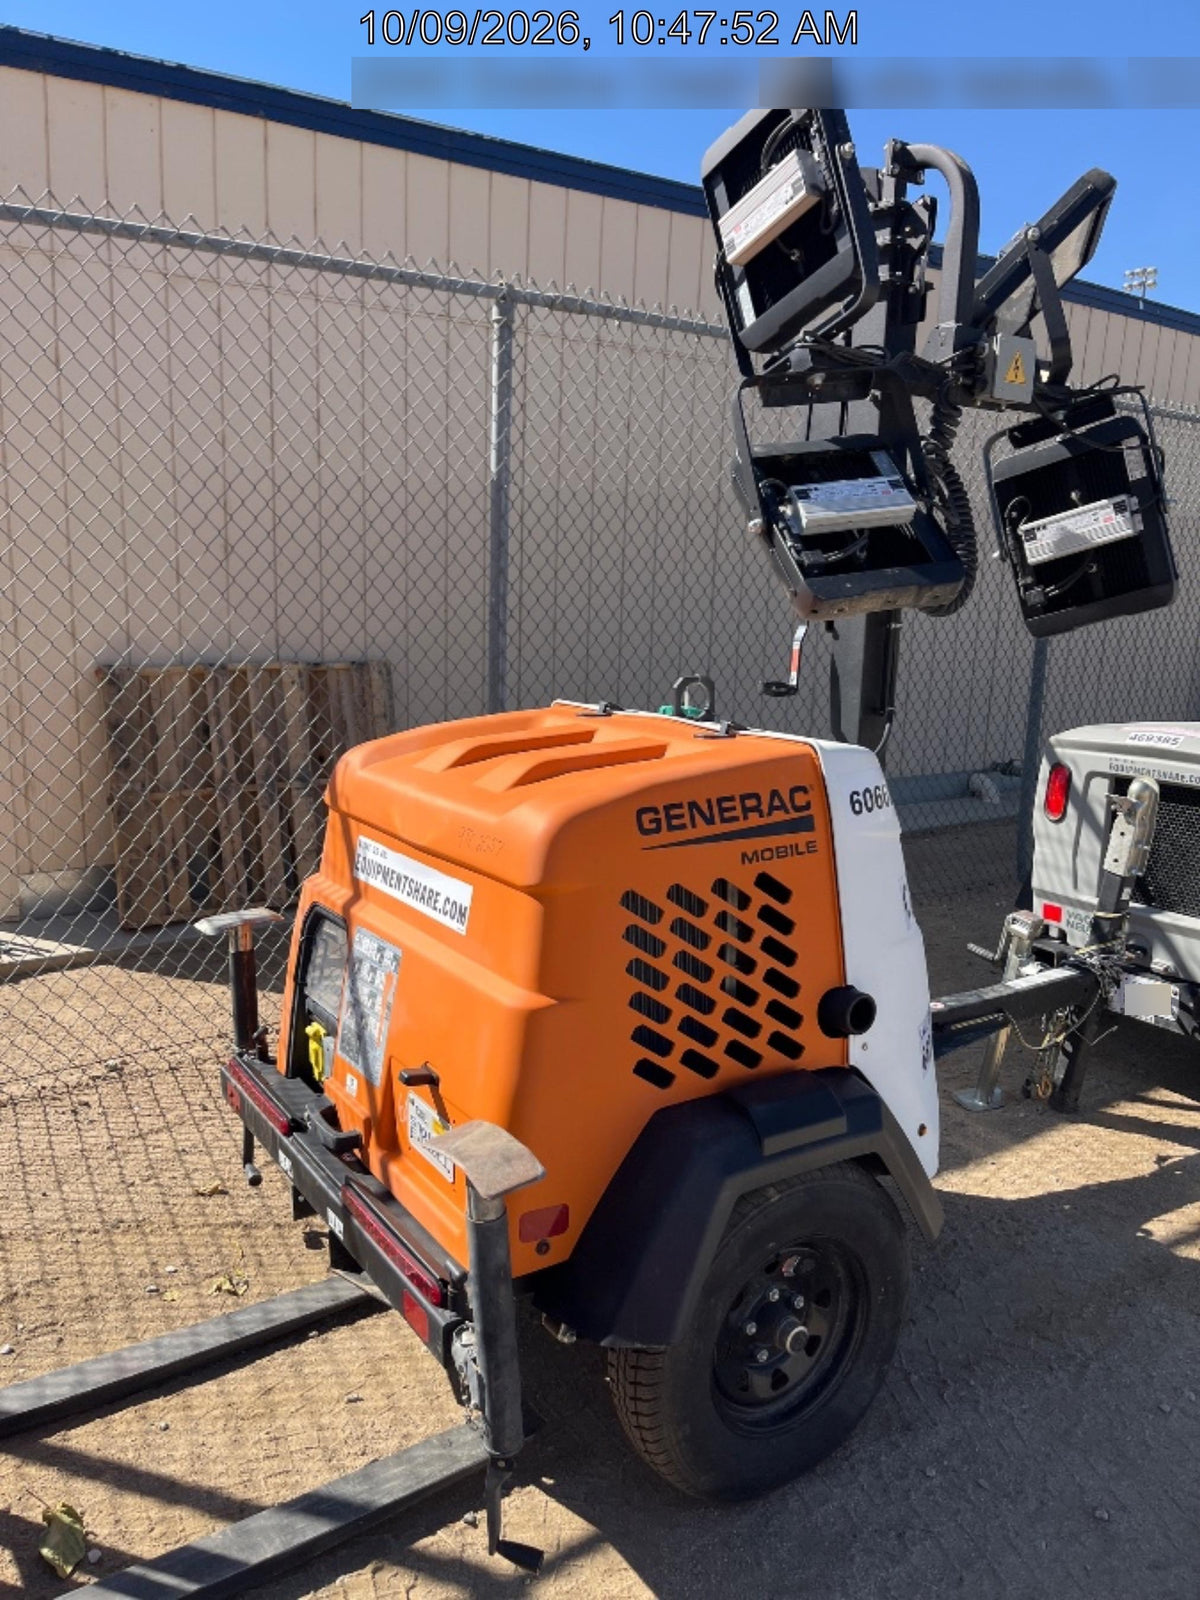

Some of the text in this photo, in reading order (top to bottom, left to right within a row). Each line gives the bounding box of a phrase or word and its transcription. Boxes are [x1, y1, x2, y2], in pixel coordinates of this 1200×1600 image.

[636, 785, 812, 836] GENERAC
[741, 840, 818, 865] MOBILE
[354, 852, 468, 927] EQUIPMENTSHARE.COM
